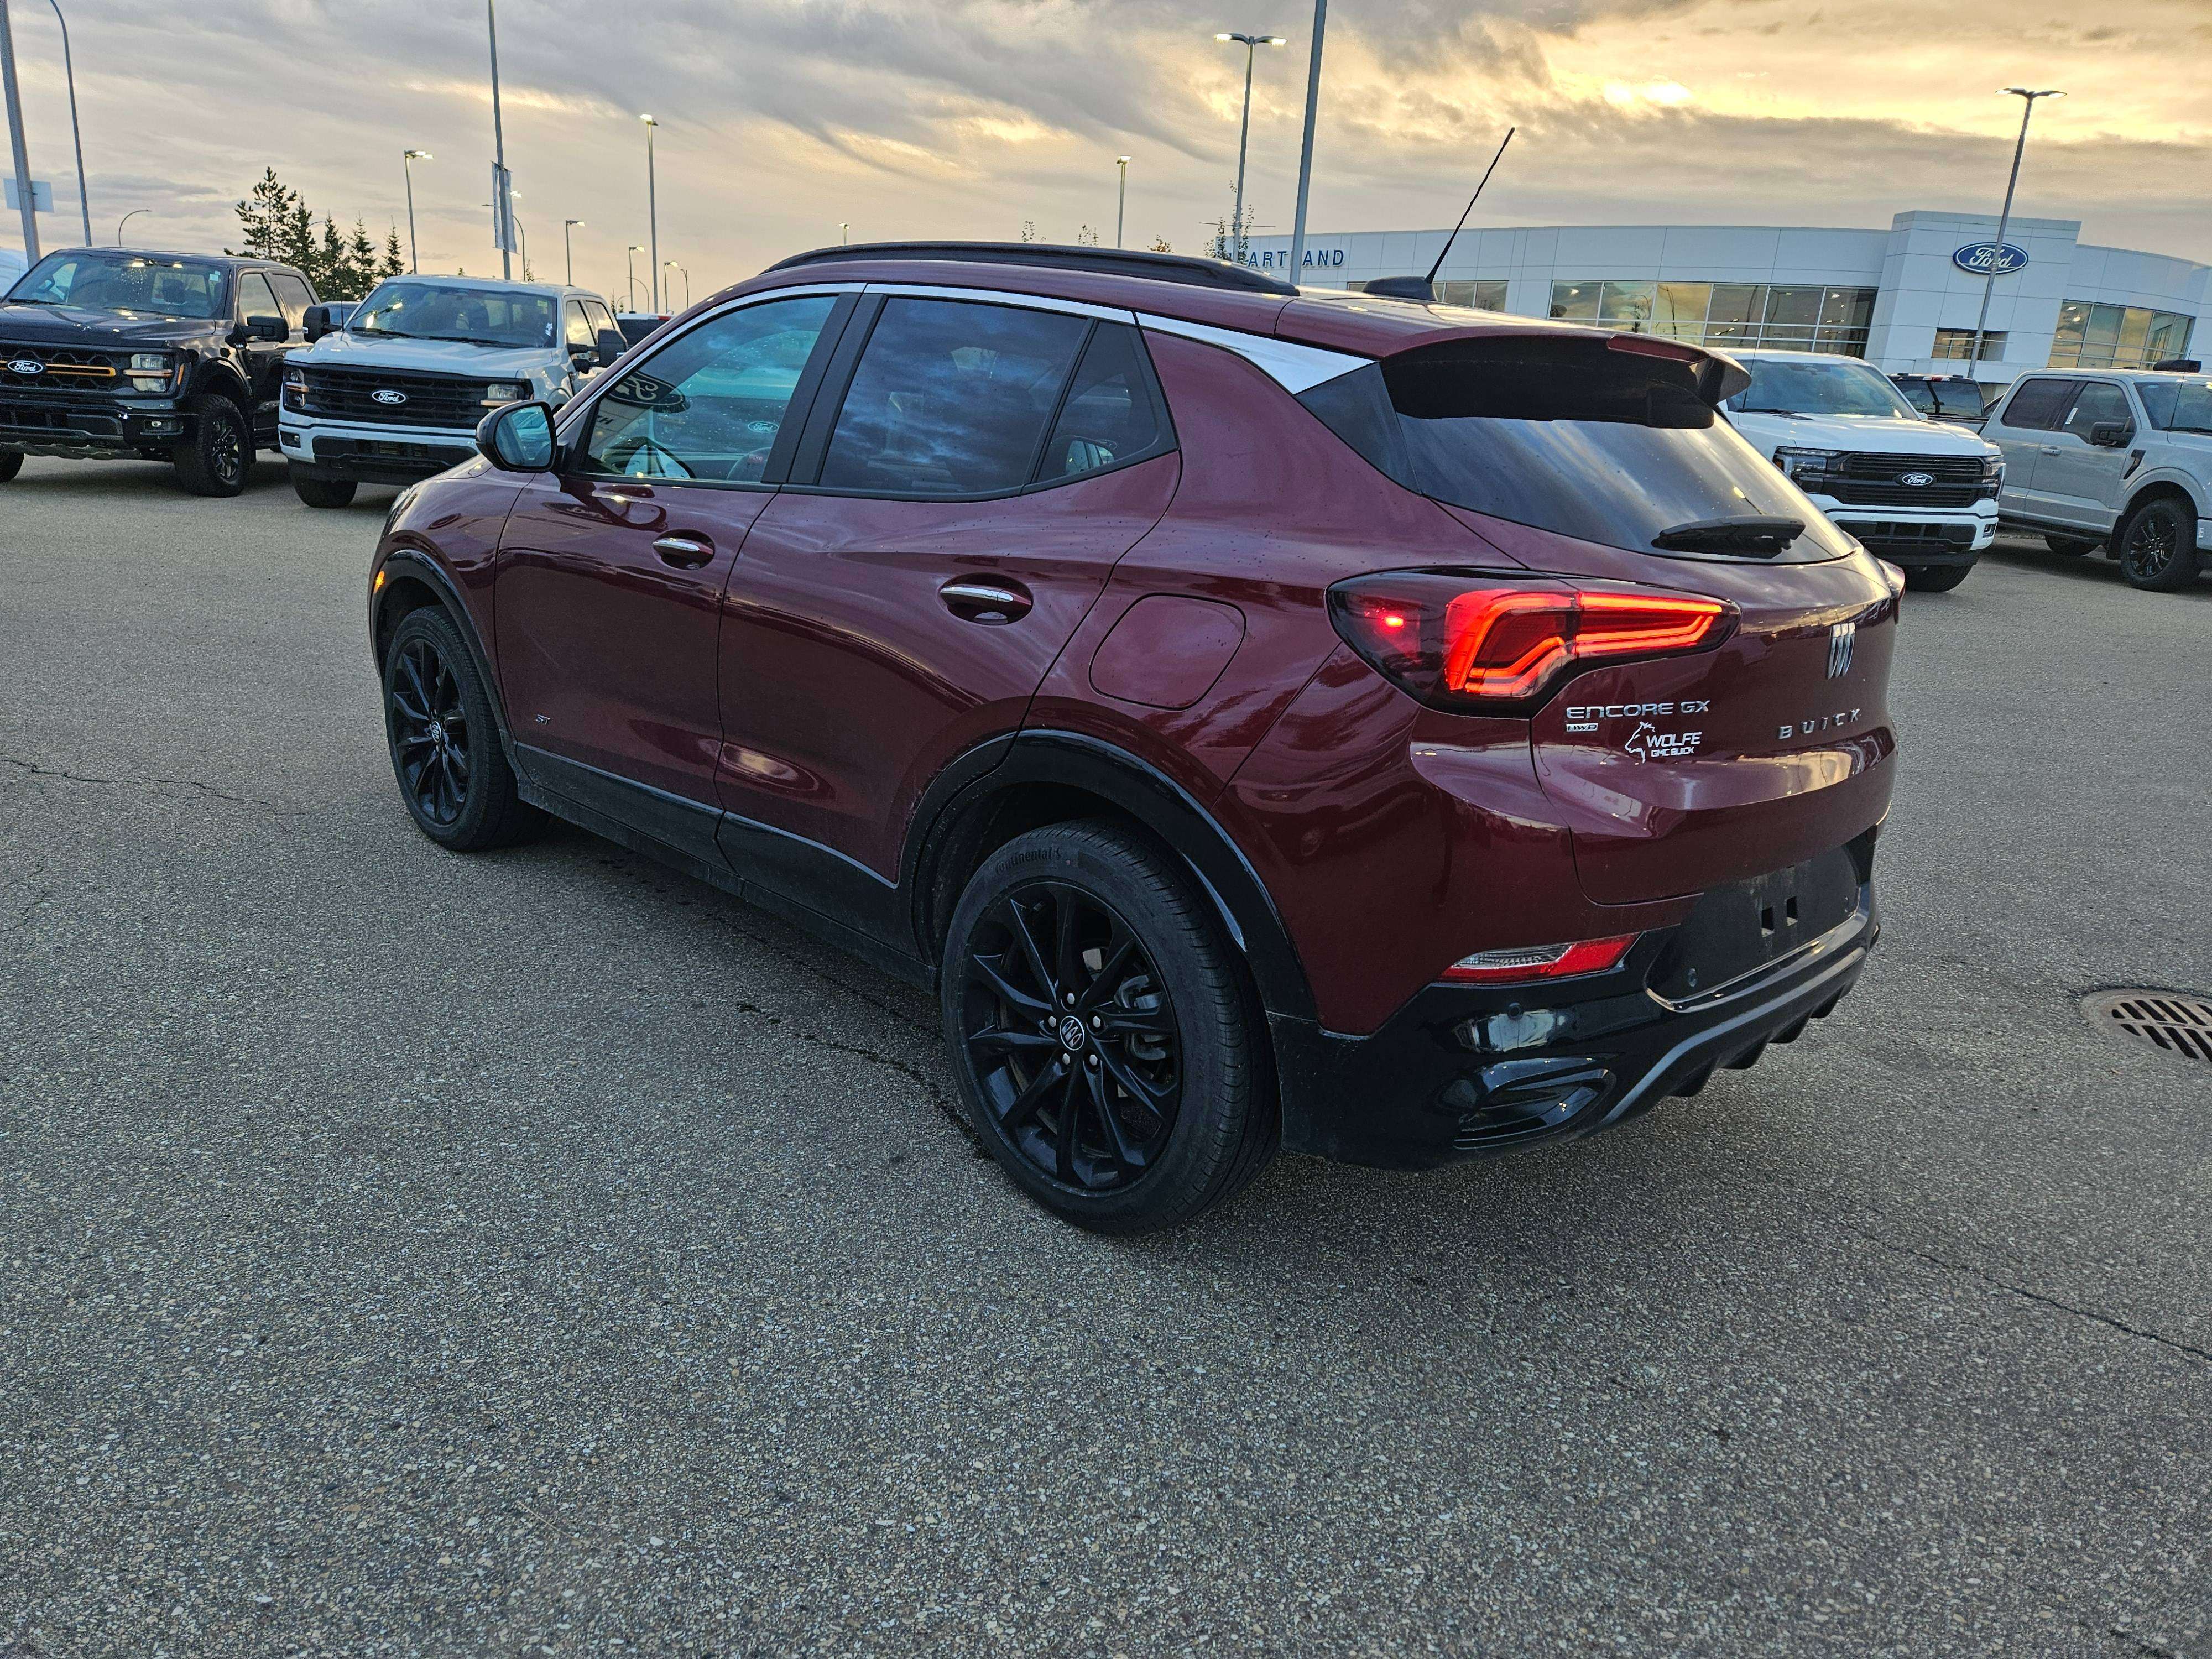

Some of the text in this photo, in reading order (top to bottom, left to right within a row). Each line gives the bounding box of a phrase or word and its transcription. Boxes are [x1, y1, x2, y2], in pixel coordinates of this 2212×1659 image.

[1221, 249, 1344, 267] ARTAND
[1969, 247, 2015, 268] Fod
[14, 362, 36, 372] Ford
[378, 392, 399, 402] Ford
[753, 422, 773, 431] Ford
[1907, 475, 1928, 484] Ford
[1566, 700, 1710, 719] ENCORE GX
[1567, 723, 1598, 732] AWD
[1777, 708, 1861, 740] BUICK
[1646, 732, 1703, 748] WOLFE
